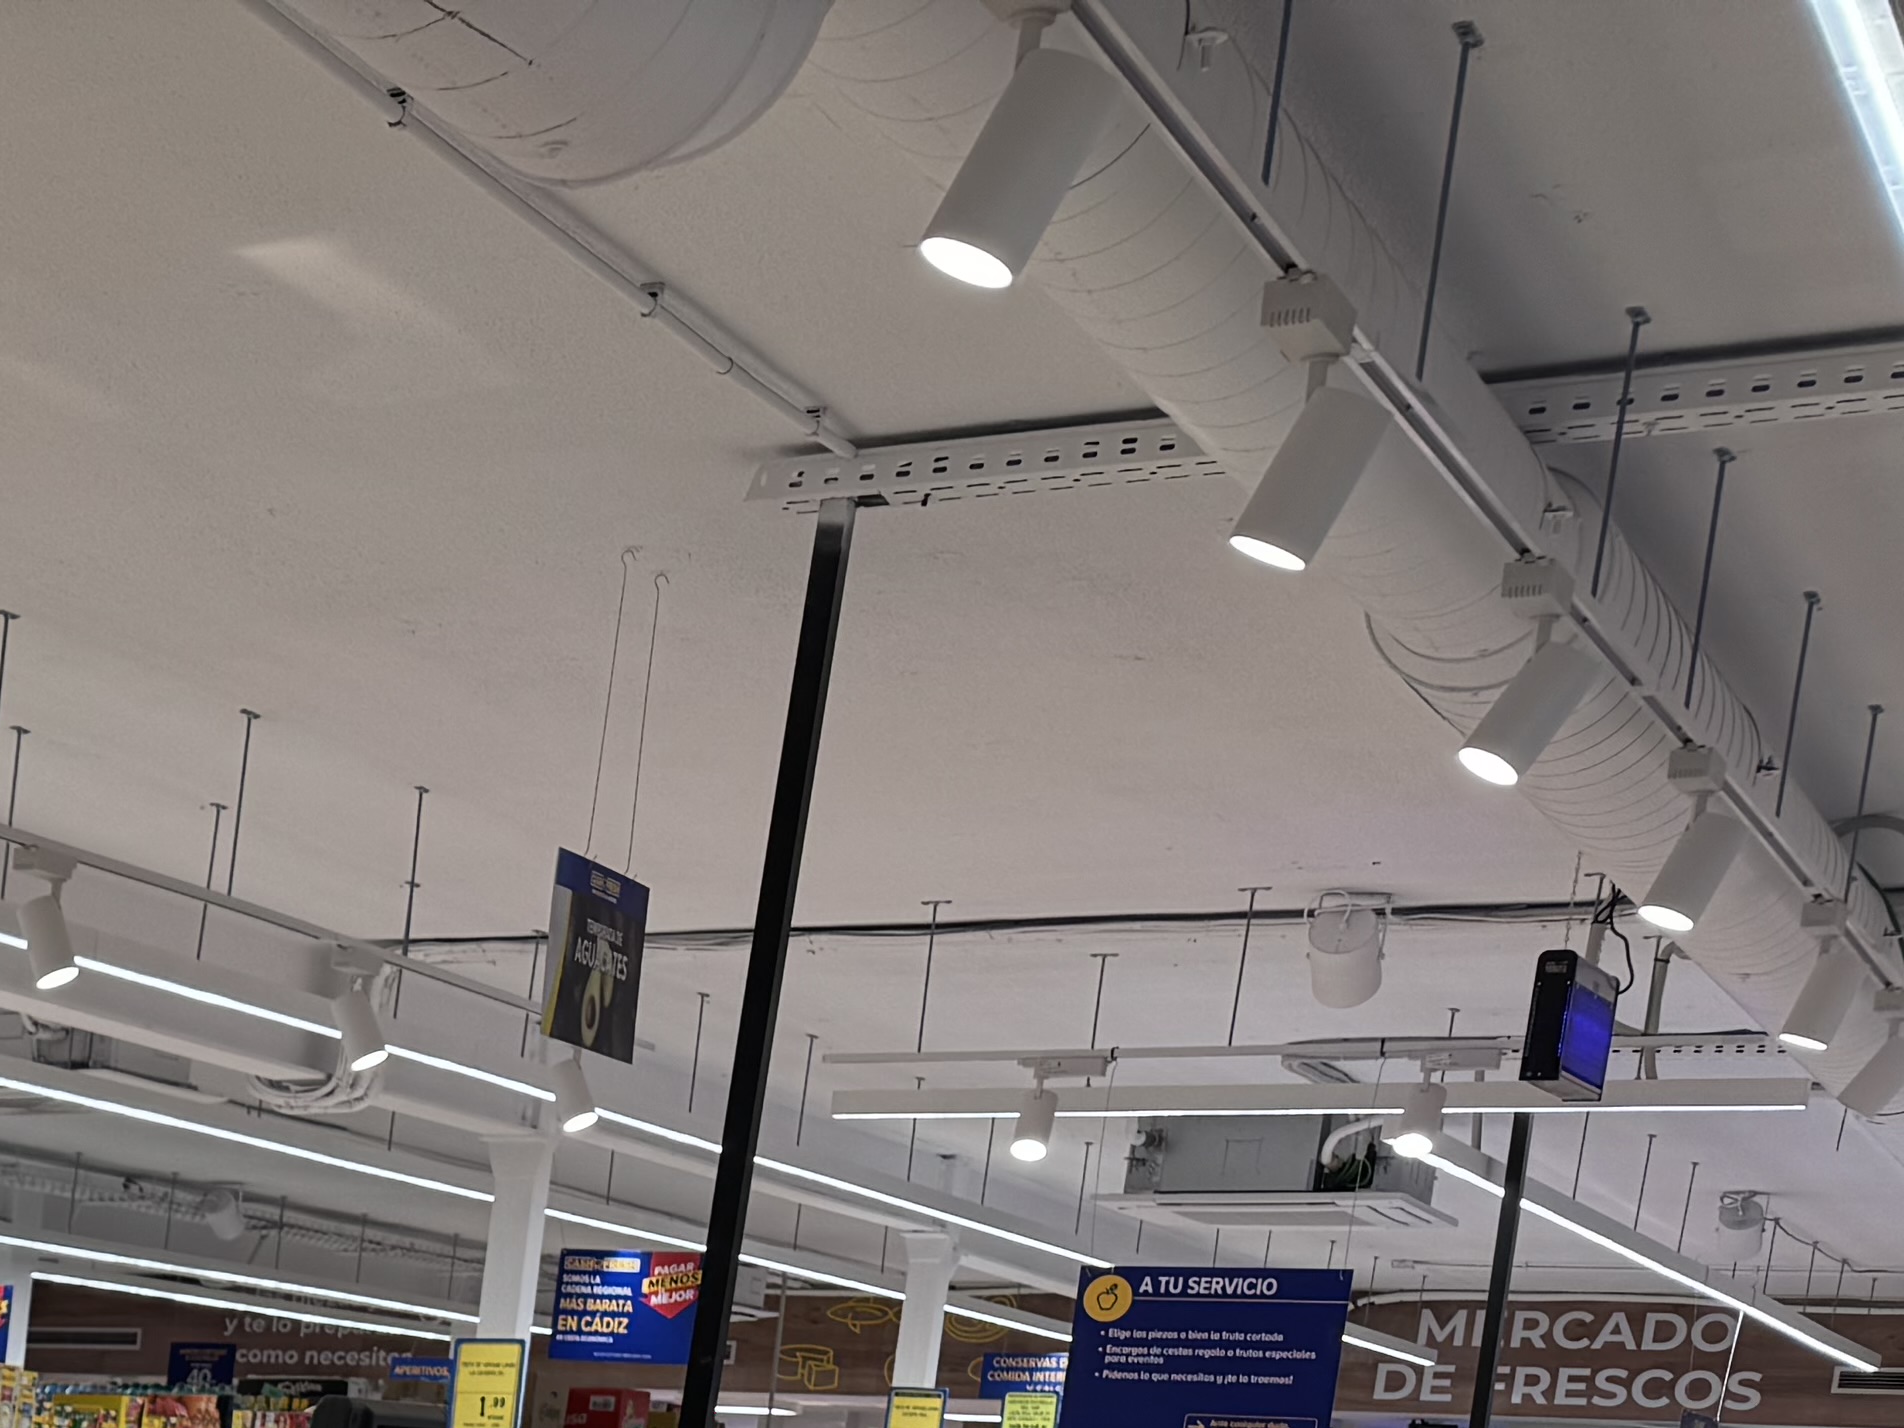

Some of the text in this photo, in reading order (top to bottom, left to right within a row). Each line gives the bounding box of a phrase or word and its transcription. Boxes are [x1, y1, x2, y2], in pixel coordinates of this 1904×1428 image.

[575, 937, 628, 981] AGUACATES
[655, 1262, 694, 1275] PAGAR
[648, 1273, 699, 1288] MENOS
[1139, 1278, 1278, 1295] A TU SERVICIO
[560, 1296, 633, 1312] MÁS BARATA
[650, 1291, 694, 1305] MEJOR
[223, 1317, 265, 1335] y te
[558, 1312, 628, 1334] EN CÁDIZ
[1108, 1329, 1130, 1340] Elige
[235, 1349, 298, 1364] como
[993, 1357, 1058, 1368] CONSERVAS
[988, 1371, 1030, 1382] COMIDA
[1373, 1364, 1456, 1401] DE
